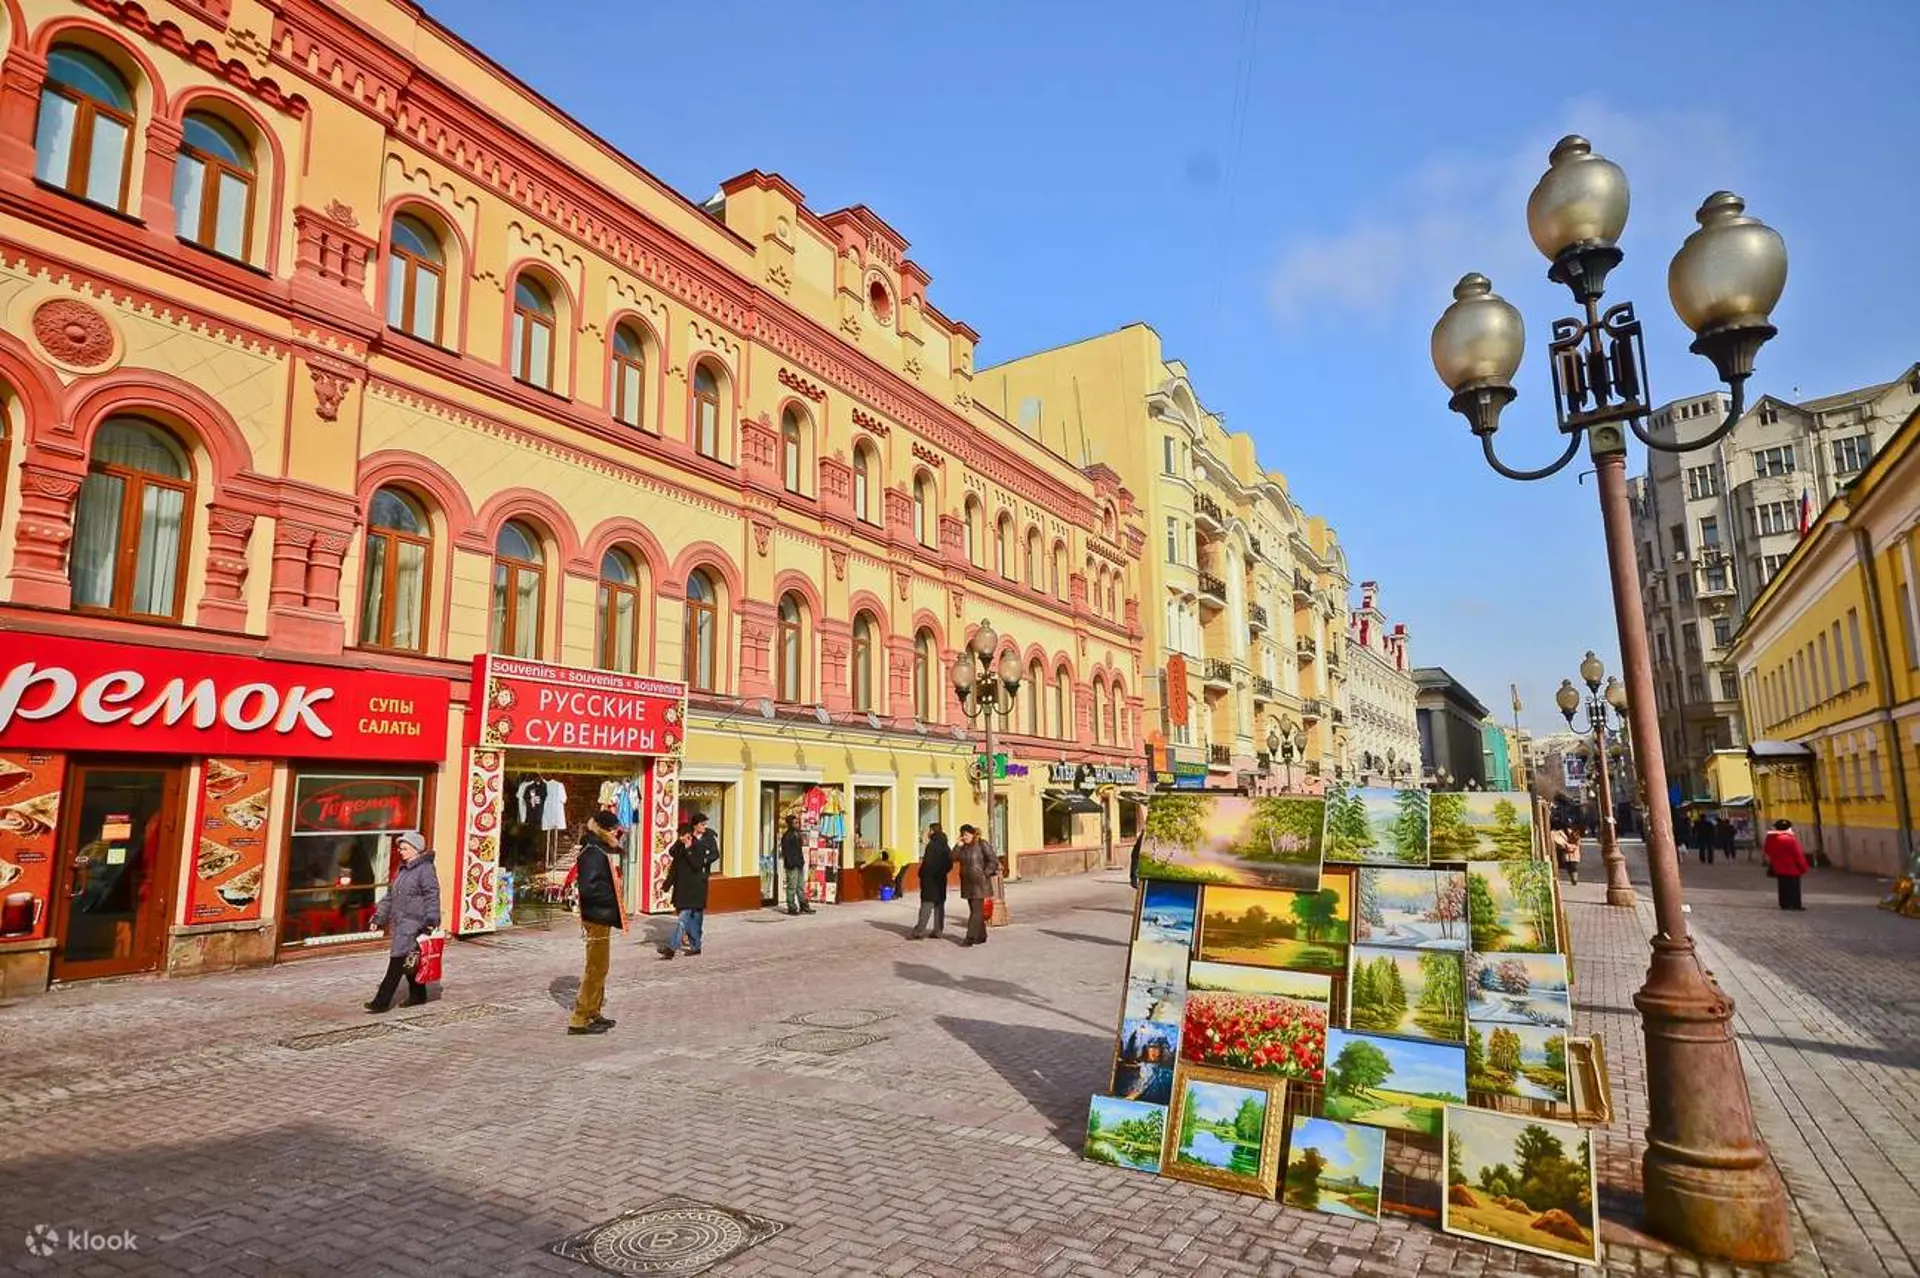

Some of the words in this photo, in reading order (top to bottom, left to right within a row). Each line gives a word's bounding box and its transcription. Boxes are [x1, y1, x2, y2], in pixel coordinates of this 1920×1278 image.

[491, 660, 557, 679] souvenirs
[568, 672, 624, 688] souvenirs
[633, 679, 683, 696] souvenirs
[368, 696, 414, 715] СУПЫ
[539, 688, 646, 721] РУССКИЕ
[358, 717, 421, 736] САЛАТЫ
[524, 718, 655, 750] СУВЕНИРЫ
